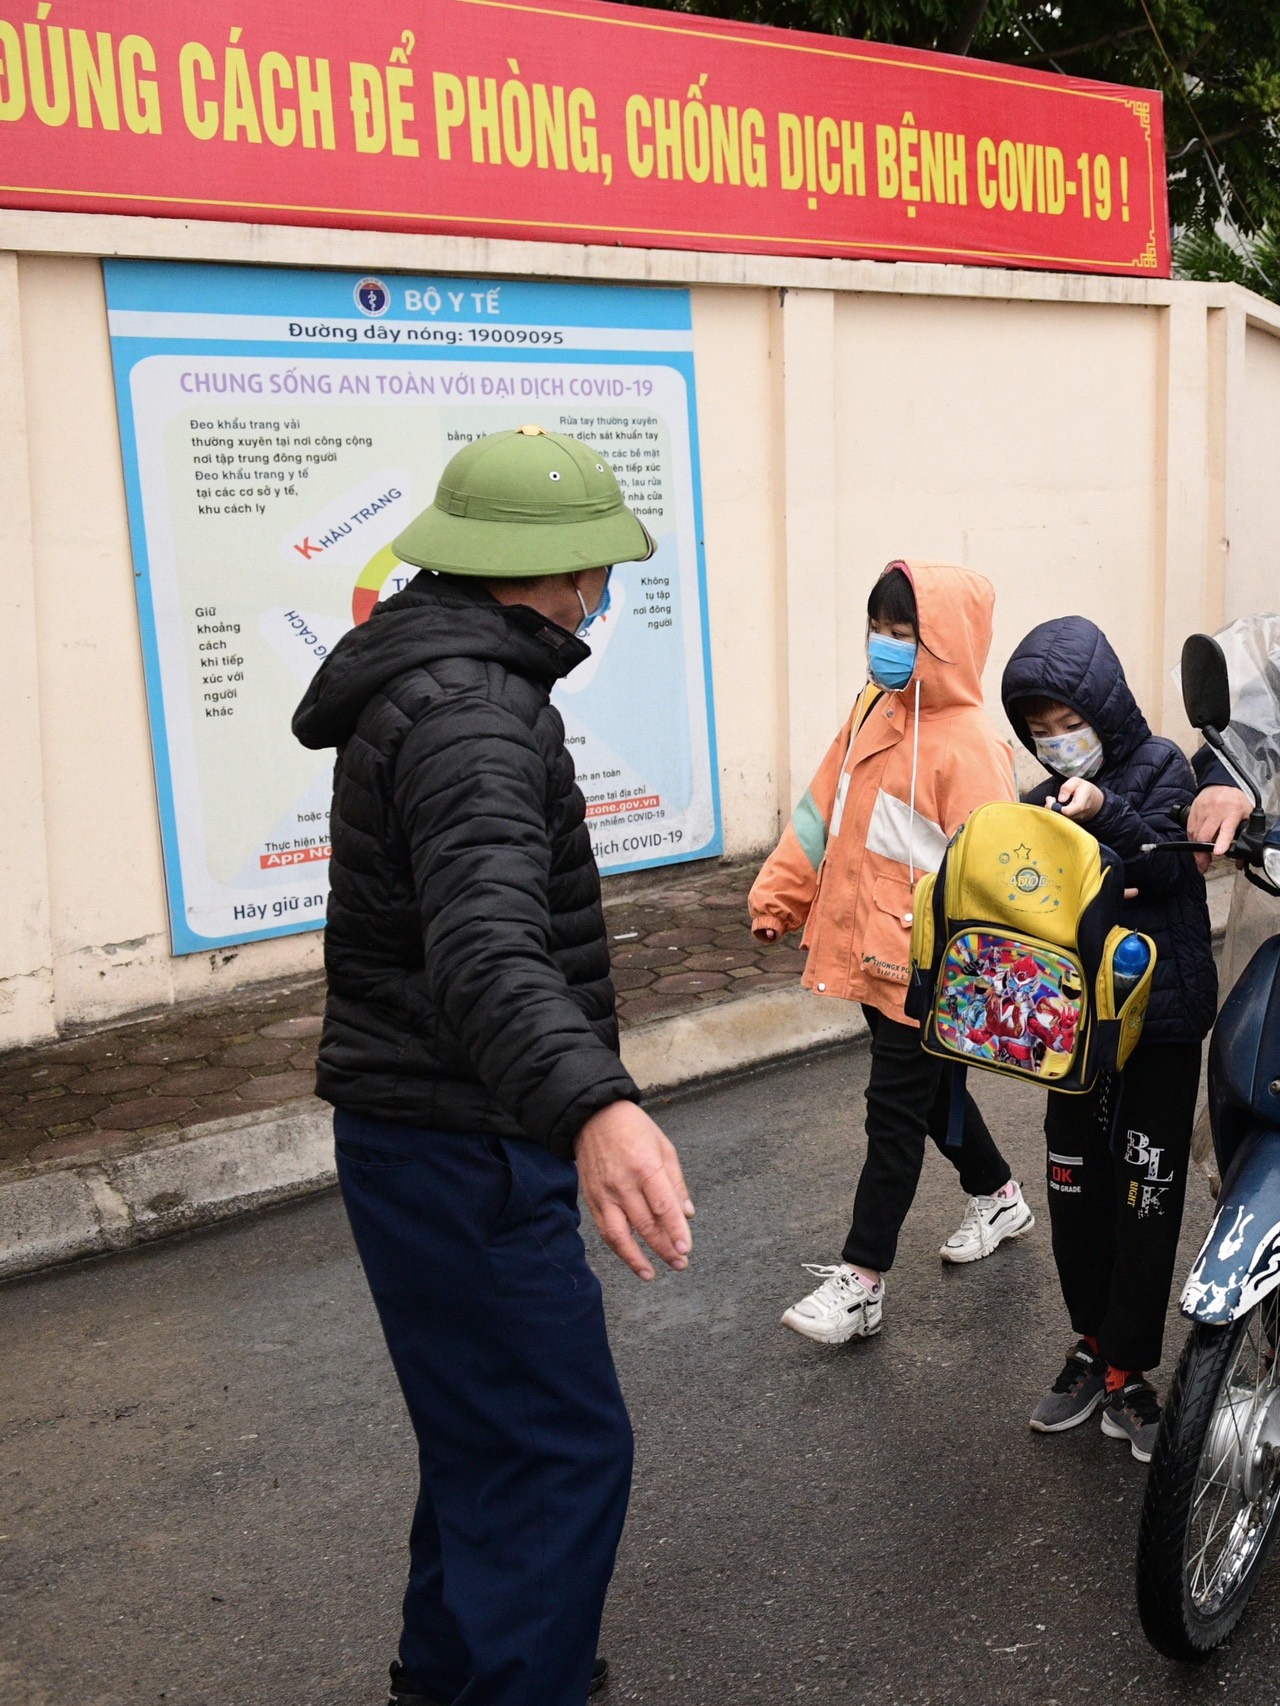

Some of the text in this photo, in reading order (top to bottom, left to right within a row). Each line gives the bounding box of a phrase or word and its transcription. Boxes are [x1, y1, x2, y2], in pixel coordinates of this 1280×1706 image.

[179, 27, 336, 150] CÁCH
[349, 29, 420, 158] ĐỂ
[433, 58, 613, 185] PHÒNG,
[625, 73, 768, 188] CHỐNG
[778, 112, 866, 210] DỊCH
[876, 111, 968, 218] BỆNH
[976, 137, 1112, 222] COVID-19
[404, 286, 442, 316] BỘ
[447, 291, 465, 312] Y
[470, 287, 501, 314] TẾ
[288, 322, 564, 345] Đường dây nóng: 19009095
[180, 367, 654, 399] CHUNG SỐNG AN TOÀN VỚI ĐẠI DỊCH COVID-19
[190, 417, 301, 432] Đeo khẩu trang vải
[581, 417, 595, 426] tay
[191, 435, 373, 448] thường xuyên tại nơi công cộng
[576, 431, 597, 441] dịch
[599, 431, 613, 440] sát
[645, 431, 659, 441] tay
[193, 452, 337, 466] nơi tập trung đông người
[195, 467, 309, 481] Đeo khẩu trang y tế
[196, 487, 211, 500] tại
[215, 486, 236, 498] các
[239, 487, 254, 497] cơ
[256, 486, 271, 497] sở
[274, 488, 280, 498] y
[198, 503, 266, 515] khu cách ly
[350, 488, 402, 525] TRANG
[641, 577, 670, 586] Không
[645, 591, 670, 601] tụ tập
[194, 606, 216, 618] Giữ
[633, 605, 671, 615] nơi đông
[197, 621, 241, 634] khoảng
[198, 640, 227, 651] cách
[200, 654, 244, 668] khi tiếp
[202, 671, 244, 684] xúc với
[204, 688, 237, 702] người
[205, 706, 234, 718] khác
[590, 772, 601, 780] an
[607, 790, 618, 800] tại
[297, 811, 322, 823] hoặc
[627, 809, 666, 823] COVID-19
[265, 840, 291, 853] Thực
[293, 836, 316, 848] hiện
[592, 829, 683, 858] dịch COVID-19
[267, 854, 305, 866] App
[233, 894, 324, 921] Hãy giữ an
[877, 968, 906, 981] SIMPLE
[1060, 1185, 1082, 1193] GRADE
[1127, 1180, 1139, 1208] RIGHT
